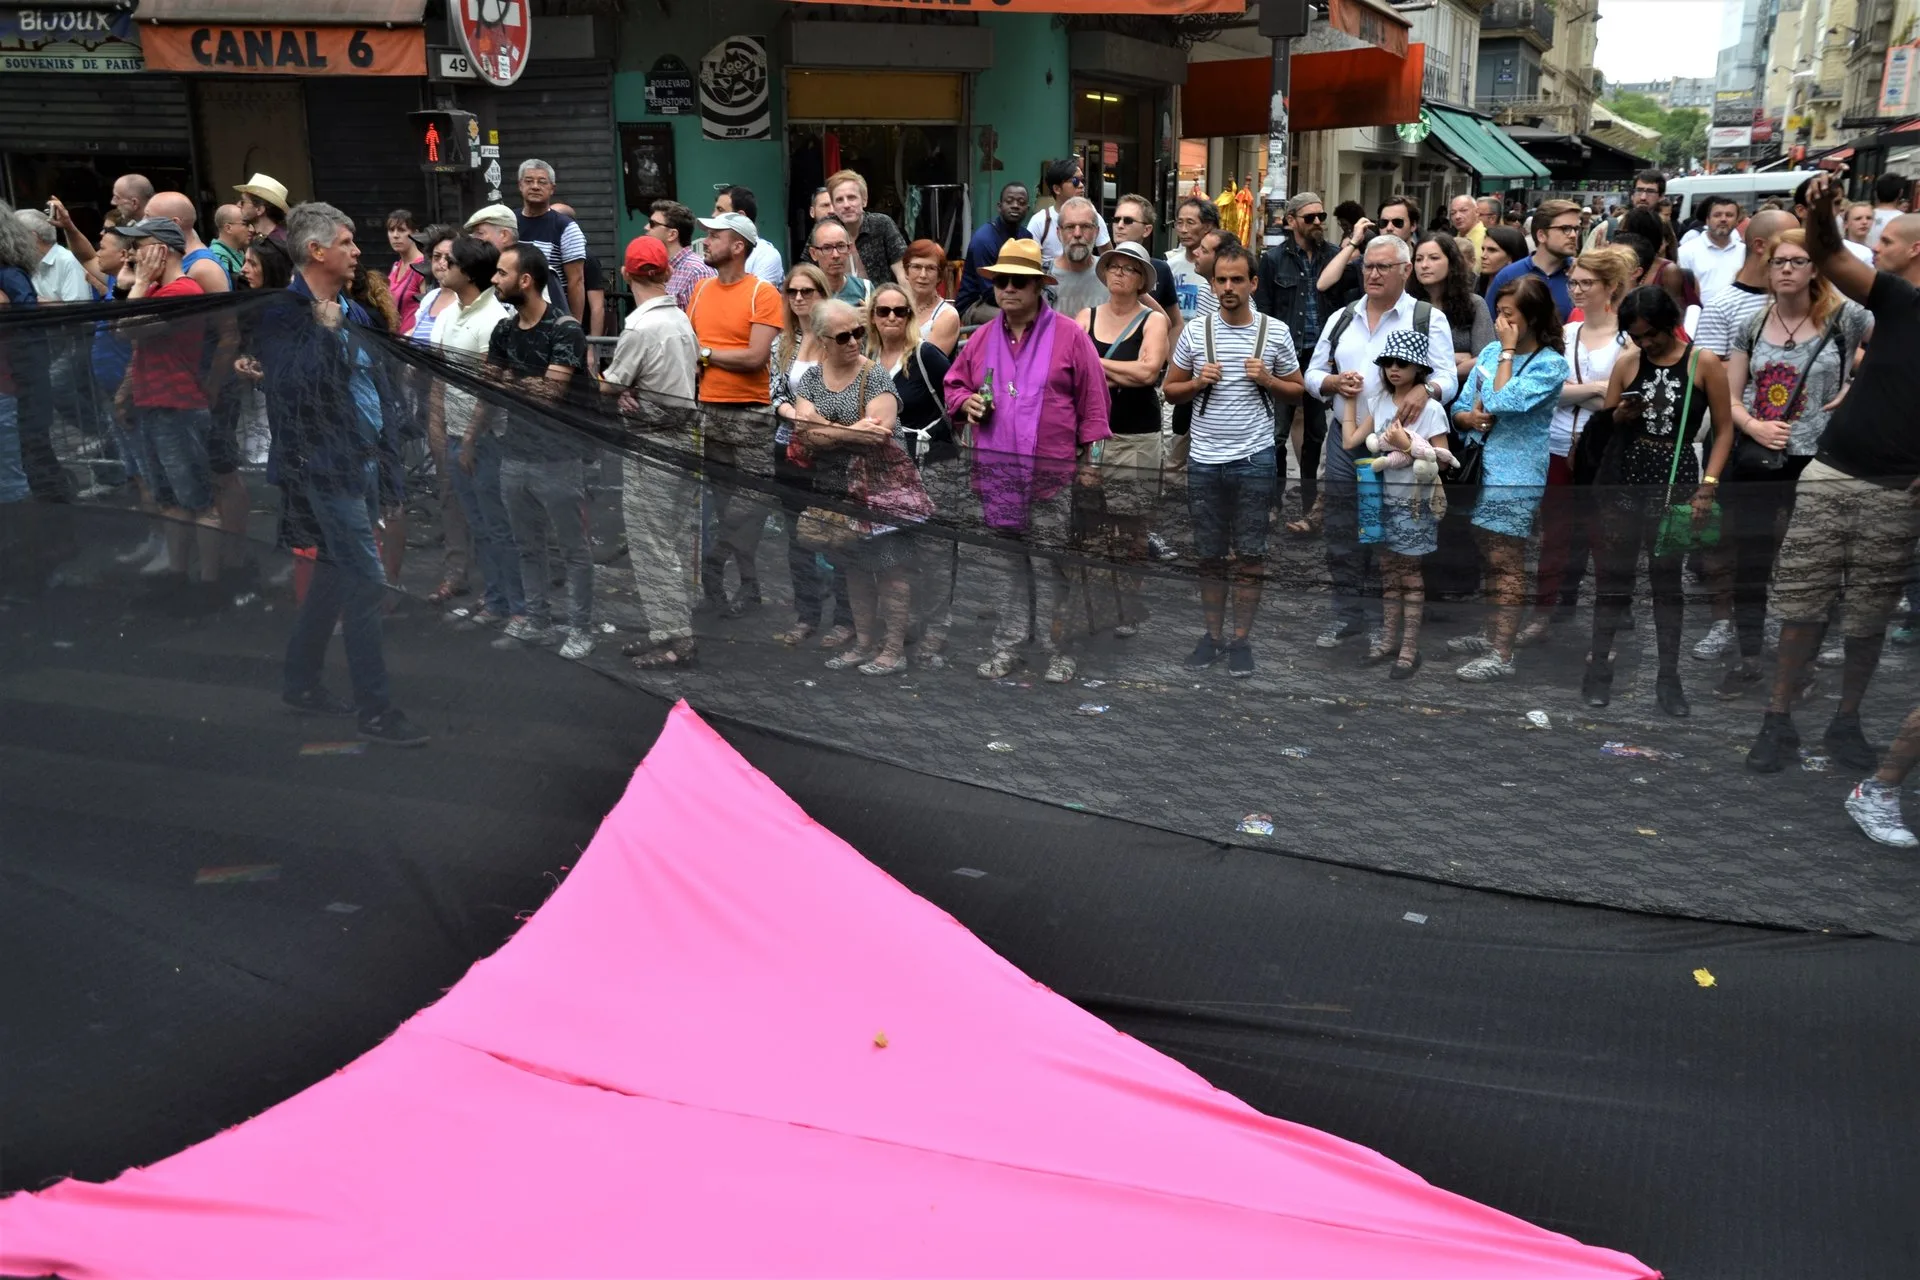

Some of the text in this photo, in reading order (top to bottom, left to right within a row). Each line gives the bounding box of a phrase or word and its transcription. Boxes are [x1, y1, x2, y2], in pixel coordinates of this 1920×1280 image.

[190, 28, 374, 68] CANAL 6
[5, 58, 142, 70] SOUVENIRS DE PARIS
[449, 58, 468, 73] 49
[651, 80, 690, 88] BOULEVARD
